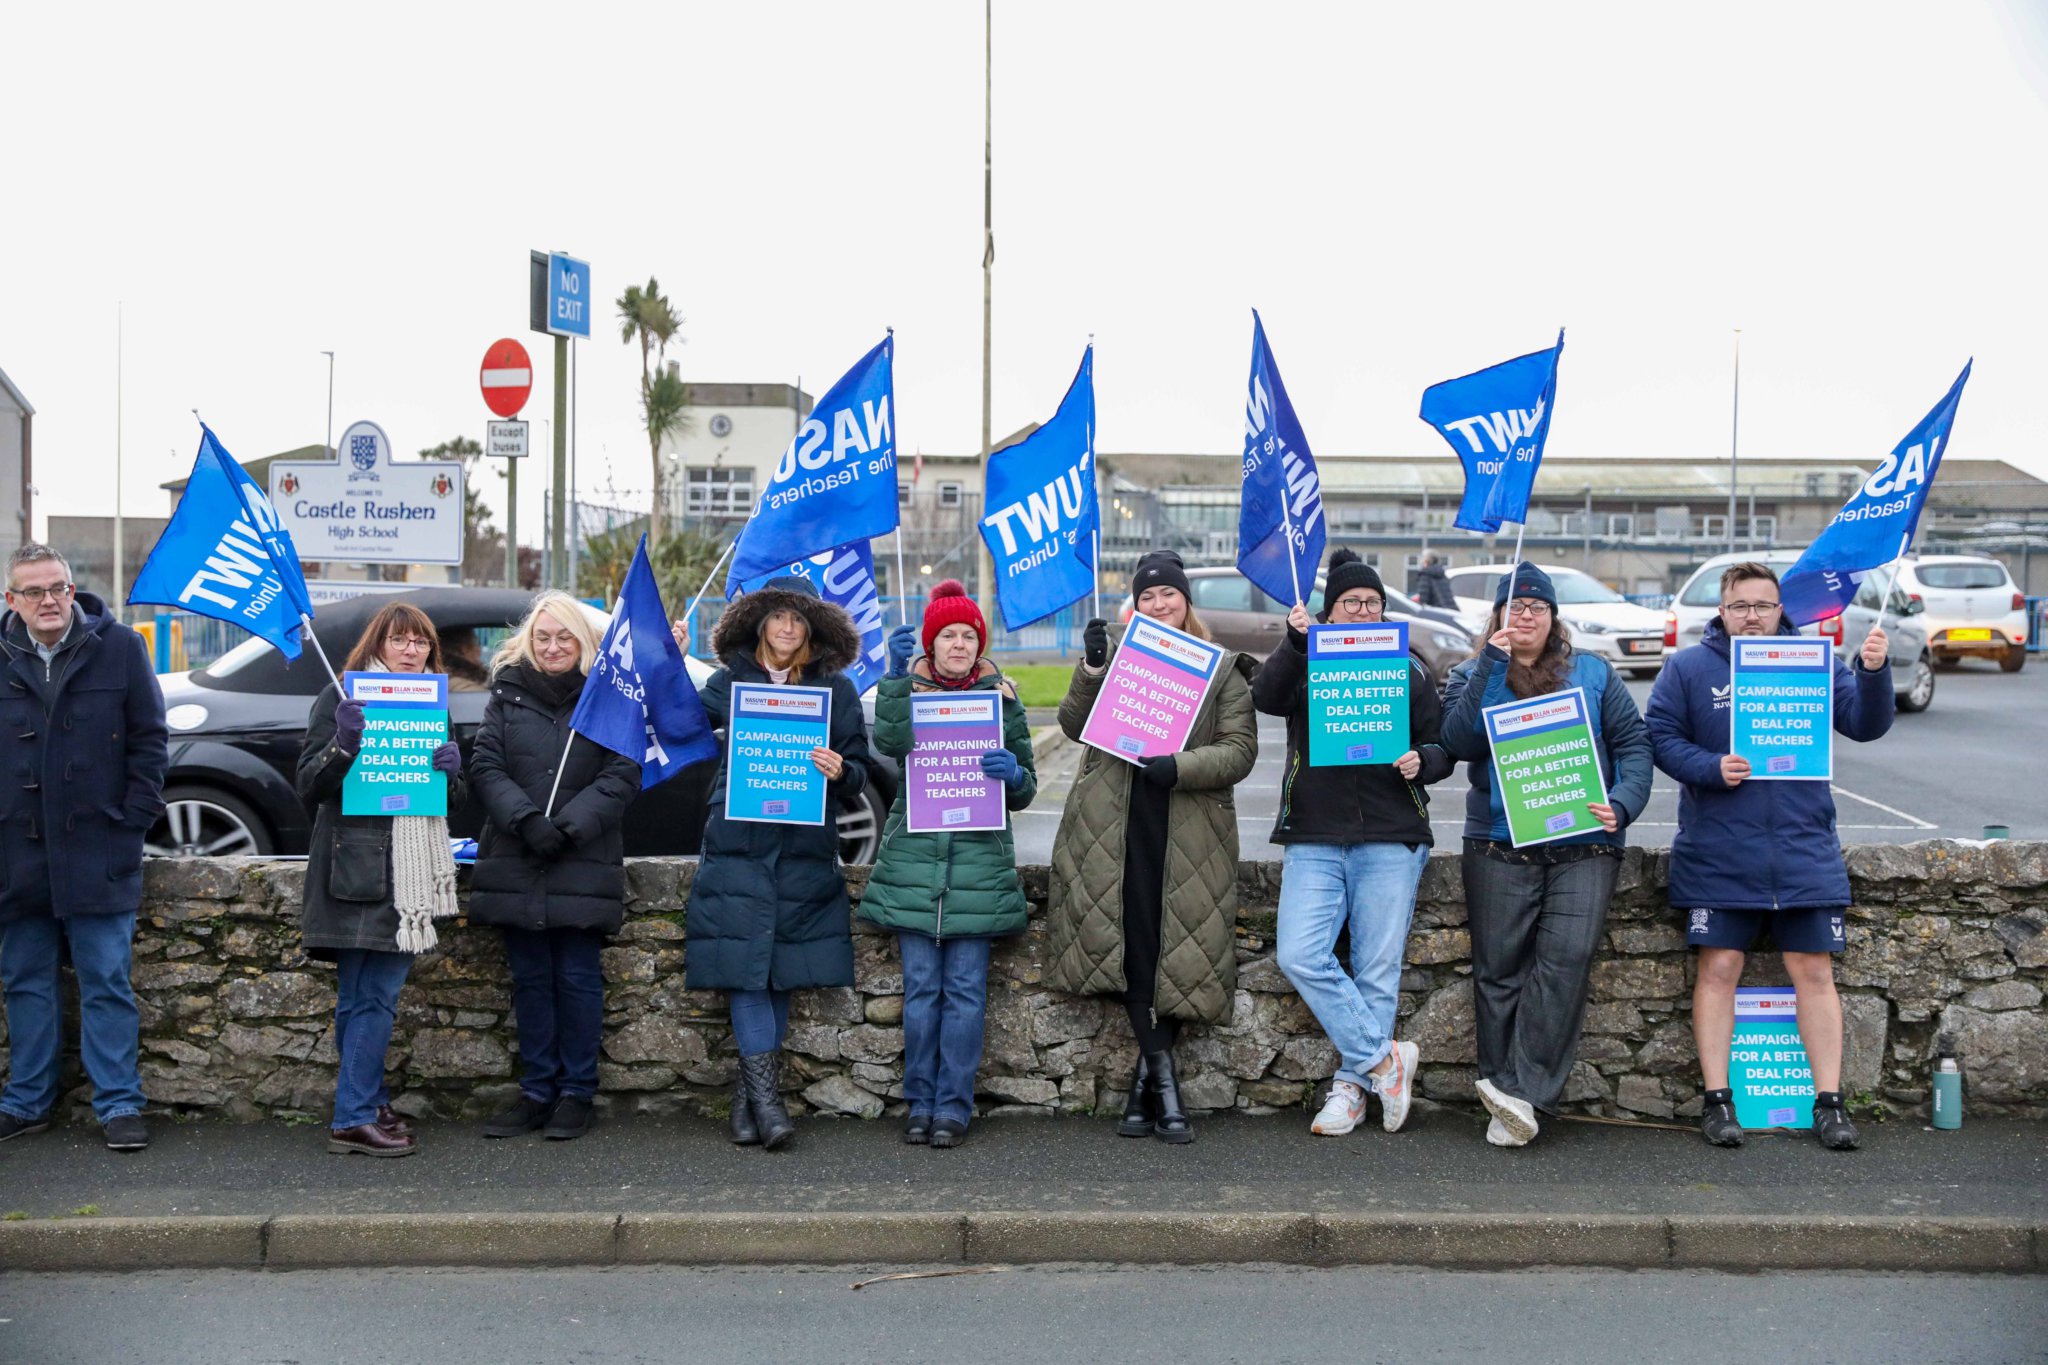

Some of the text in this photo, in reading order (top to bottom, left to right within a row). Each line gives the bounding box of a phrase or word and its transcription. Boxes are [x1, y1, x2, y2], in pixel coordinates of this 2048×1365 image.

[561, 270, 580, 295] NO
[558, 297, 583, 322] EXIT
[491, 426, 524, 438] Except
[493, 441, 521, 452] buses
[294, 500, 436, 520] Castle Rushen
[328, 526, 399, 540] High School
[1118, 660, 1199, 701] CAMPAIGNING
[1310, 670, 1406, 682] CAMPAIGNING
[1114, 675, 1191, 714] FOR A BETTER
[1313, 687, 1404, 700] FOR A BETTER
[1737, 686, 1826, 697] CAMPAIGNING
[1118, 695, 1174, 724] DEAL FOR
[1326, 704, 1391, 717] DEAL FOR
[1740, 703, 1824, 713] FOR A BETTER
[363, 720, 445, 732] MPAIGNING
[1111, 708, 1169, 740] TEACHERS
[1324, 721, 1393, 733] TEACHERS
[1752, 719, 1812, 729] DEAL FOR
[360, 738, 442, 749] OR A BETTER
[736, 731, 823, 745] CAMPAIGNING
[1750, 735, 1813, 746] TEACHERS
[738, 747, 812, 760] FOR A BETTE
[1500, 738, 1588, 765] CAMPAIGNING
[362, 755, 428, 766] DEAL FOR
[914, 756, 983, 767] FOR A BETT
[749, 763, 807, 775] DEAL FOR
[1506, 754, 1590, 781] FOR A BETTER
[360, 772, 430, 783] TEACHERS
[927, 772, 984, 782] DEAL FOR
[746, 778, 808, 791] TEACHERS
[1521, 773, 1581, 794] DEAL FOR
[925, 788, 986, 798] TEACHERS
[1523, 788, 1587, 810] TEACHERS
[1731, 1034, 1800, 1045] CAMPAIGN
[1732, 1052, 1807, 1062] FOR A BETT
[1746, 1068, 1811, 1079] DEAL FOR
[1745, 1085, 1815, 1096] TEACHERS
